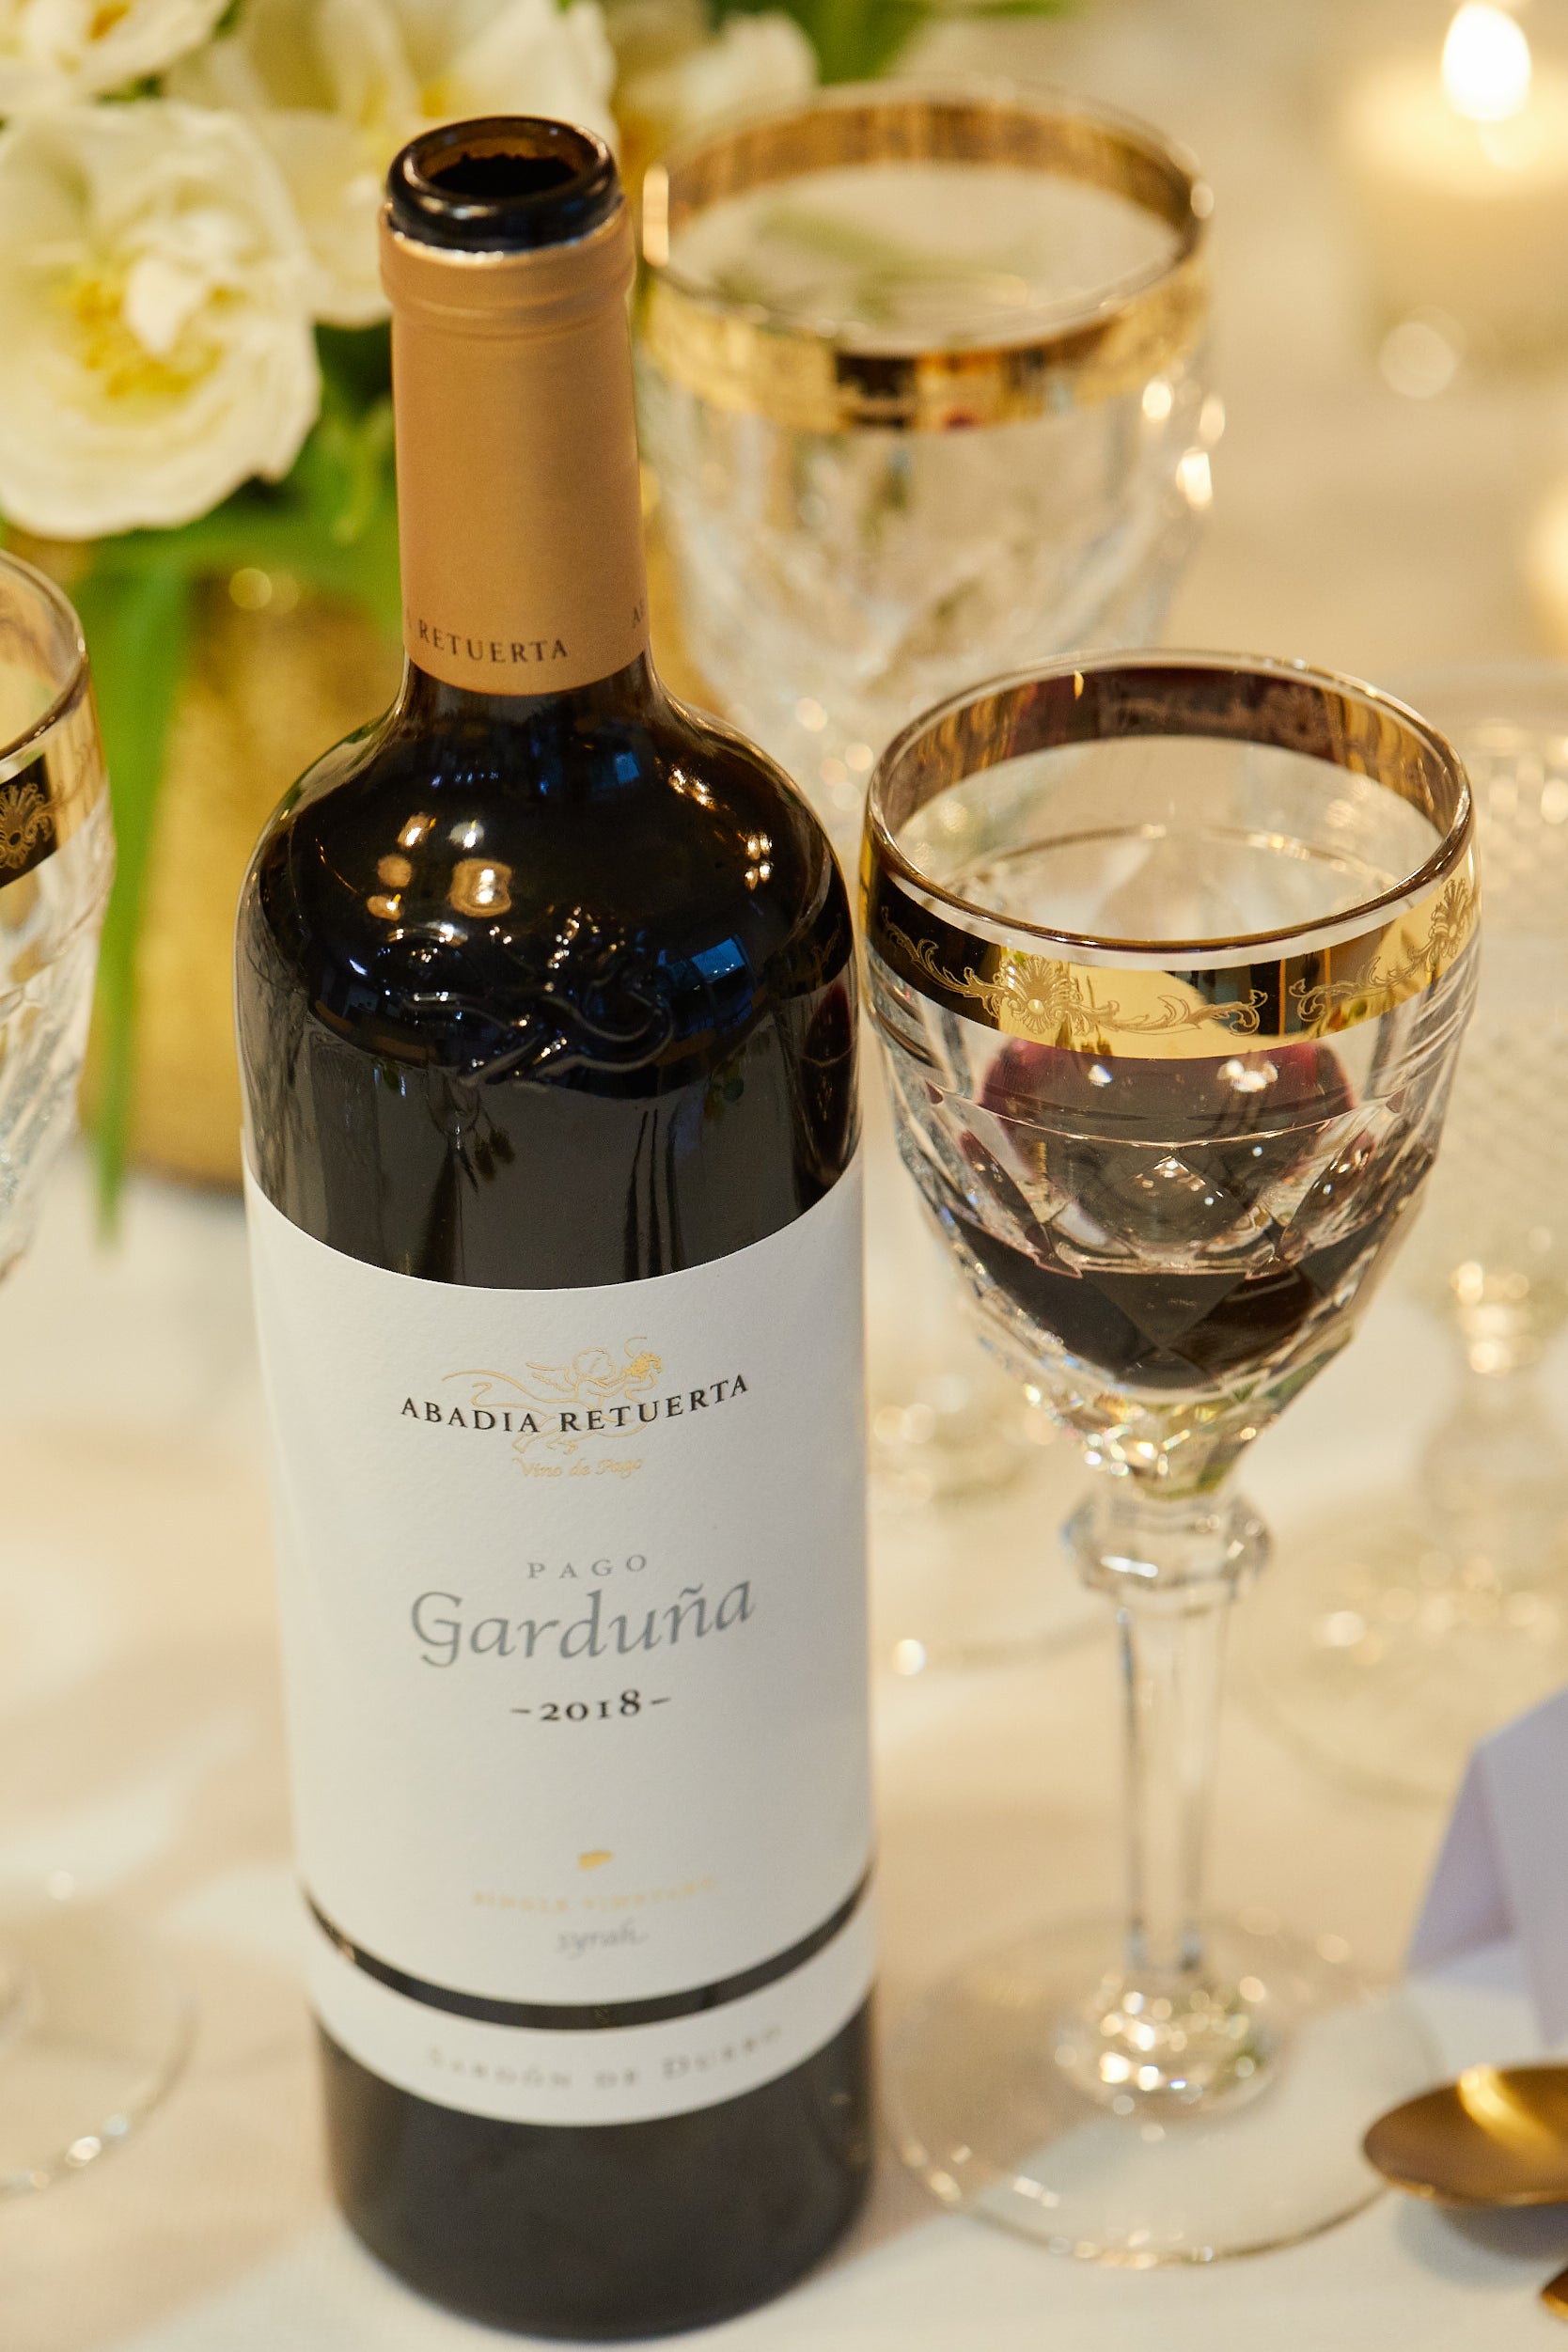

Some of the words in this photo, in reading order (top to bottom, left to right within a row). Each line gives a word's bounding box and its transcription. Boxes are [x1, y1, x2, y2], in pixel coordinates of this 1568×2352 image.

[418, 618, 569, 664] RETUERTA
[400, 1396, 541, 1434] ABADIA
[558, 1373, 750, 1433] RETUERTA
[526, 1554, 648, 1579] PAGO
[411, 1579, 757, 1669] Garduña
